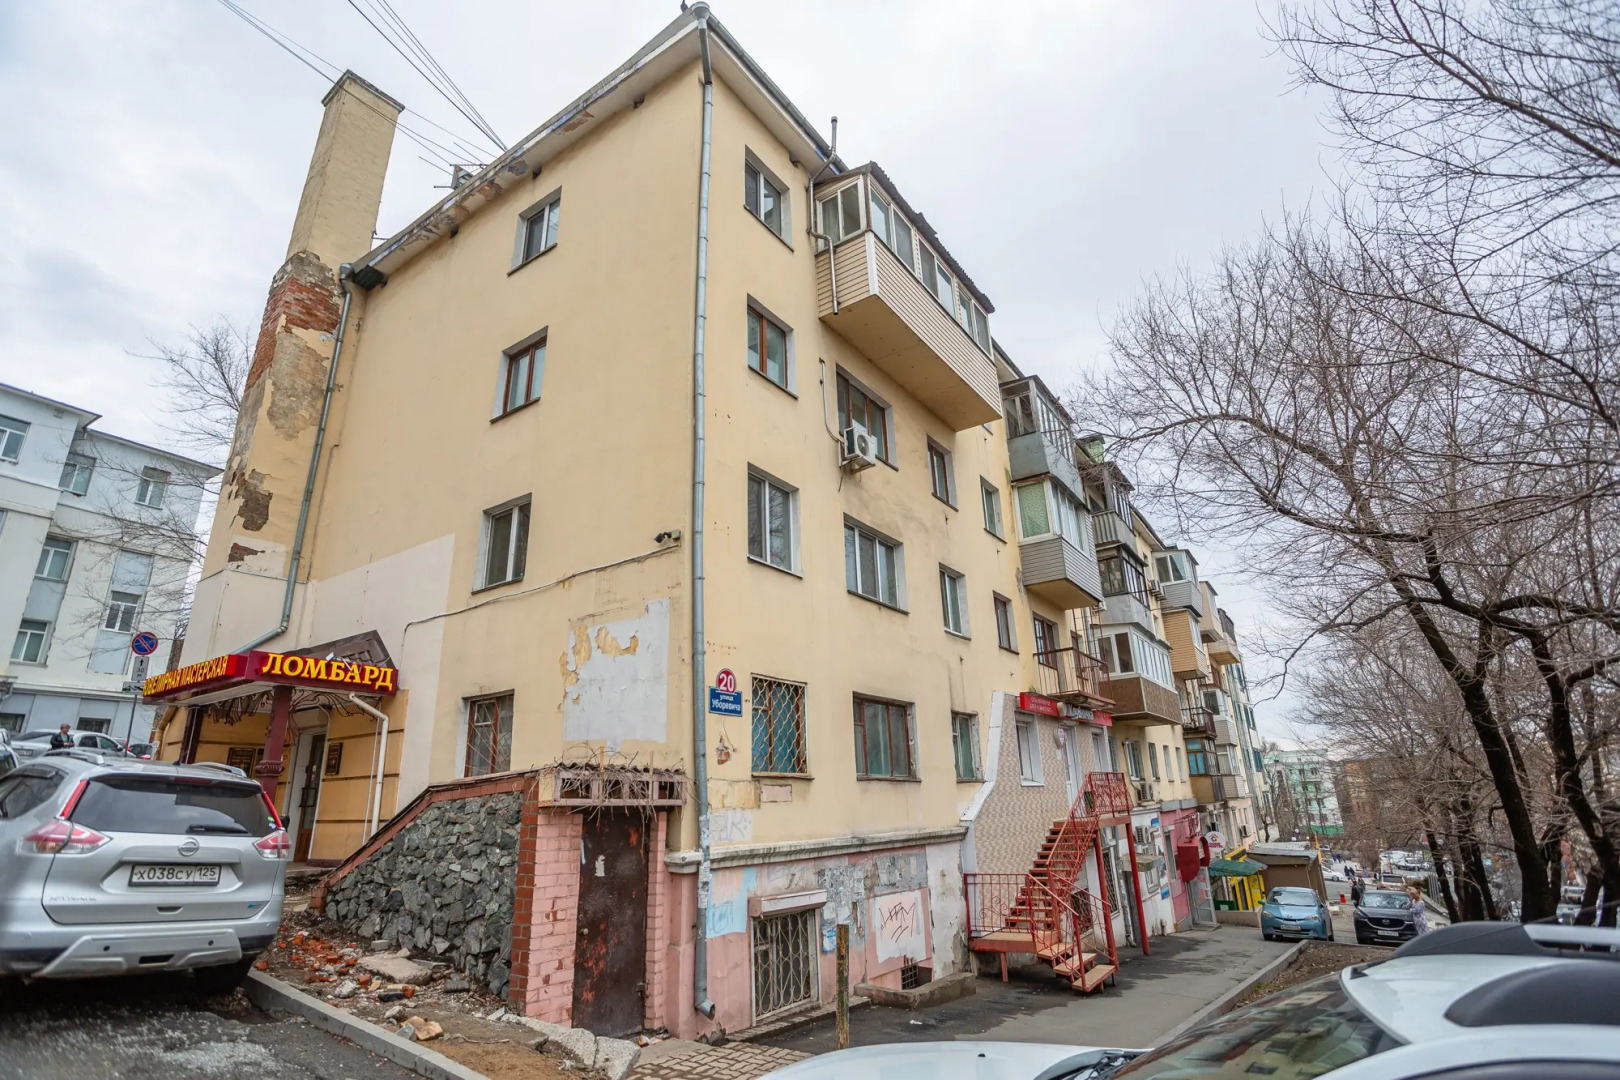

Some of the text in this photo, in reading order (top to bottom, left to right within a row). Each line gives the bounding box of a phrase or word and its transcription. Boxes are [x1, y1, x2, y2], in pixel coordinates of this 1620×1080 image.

[142, 655, 228, 696] ЮВЕЛИРНАЯ МАСТЕРСКАЯ
[262, 653, 393, 690] ЛОМБАРД
[720, 674, 734, 691] 20
[712, 699, 740, 710] Уборевича
[137, 867, 193, 881] Х038СУ
[197, 867, 217, 877] 125
